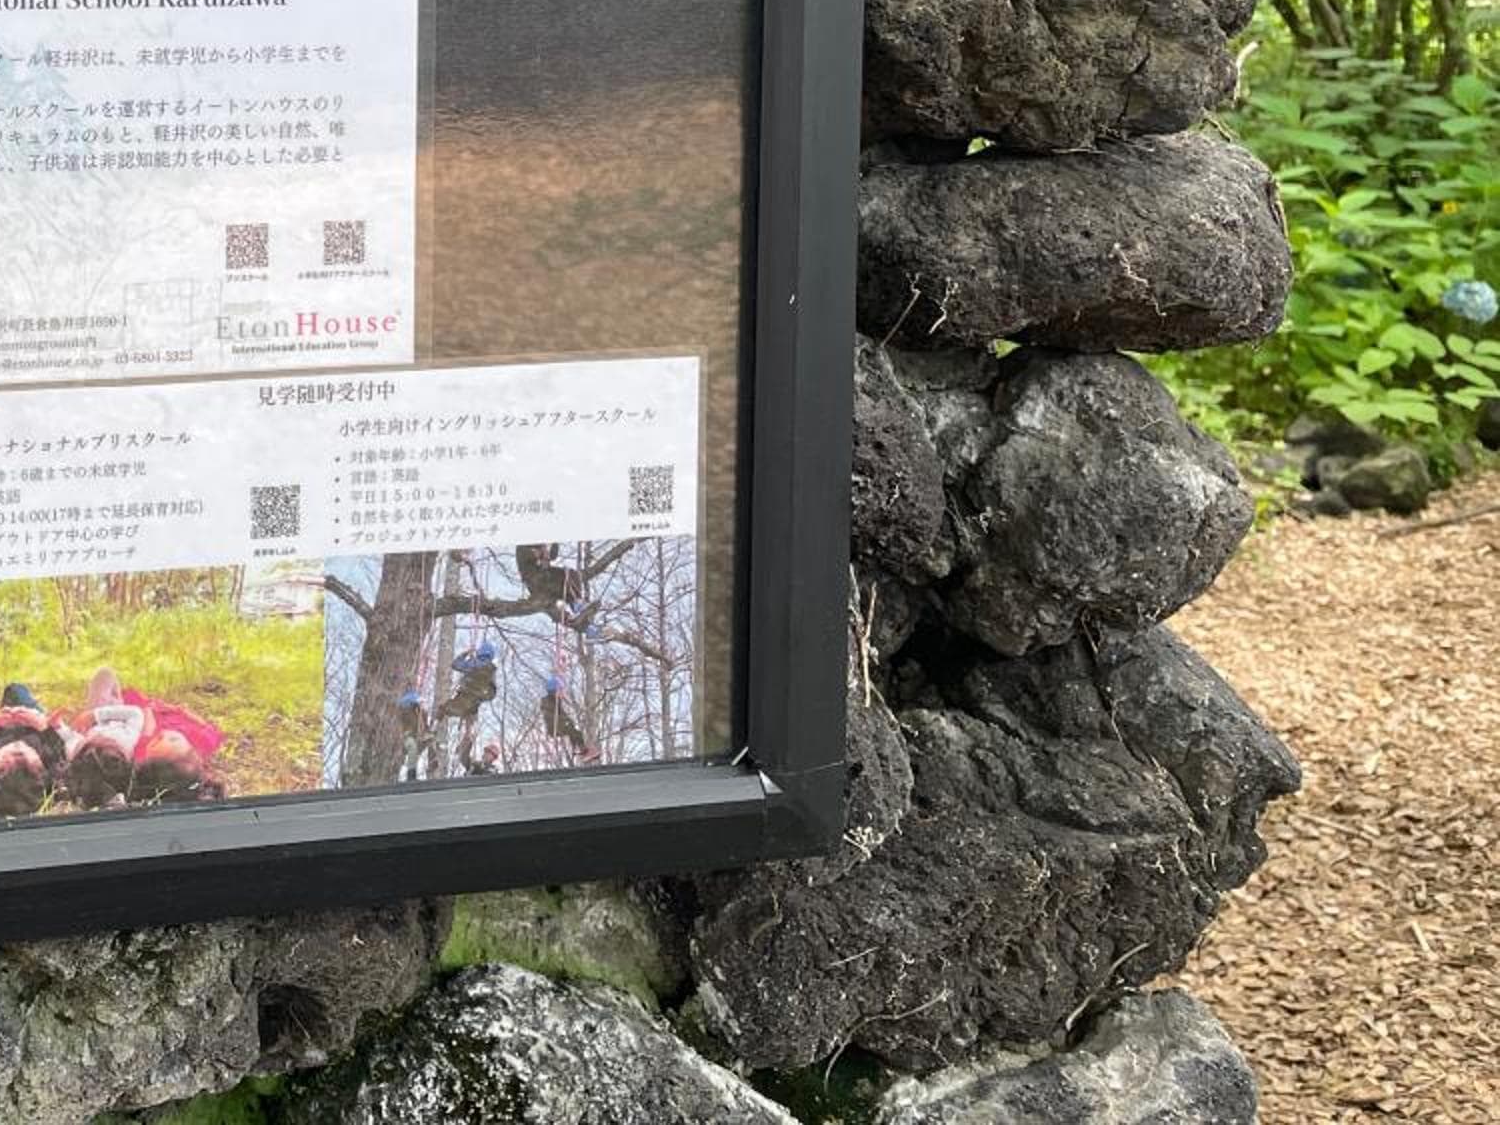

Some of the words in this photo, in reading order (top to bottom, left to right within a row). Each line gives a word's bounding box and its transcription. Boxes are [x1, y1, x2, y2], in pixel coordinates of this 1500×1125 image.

[232, 343, 296, 355] International
[258, 380, 395, 407] 見学随時受付中
[339, 407, 657, 437] 小学生向けイングリッシュアフタースクール
